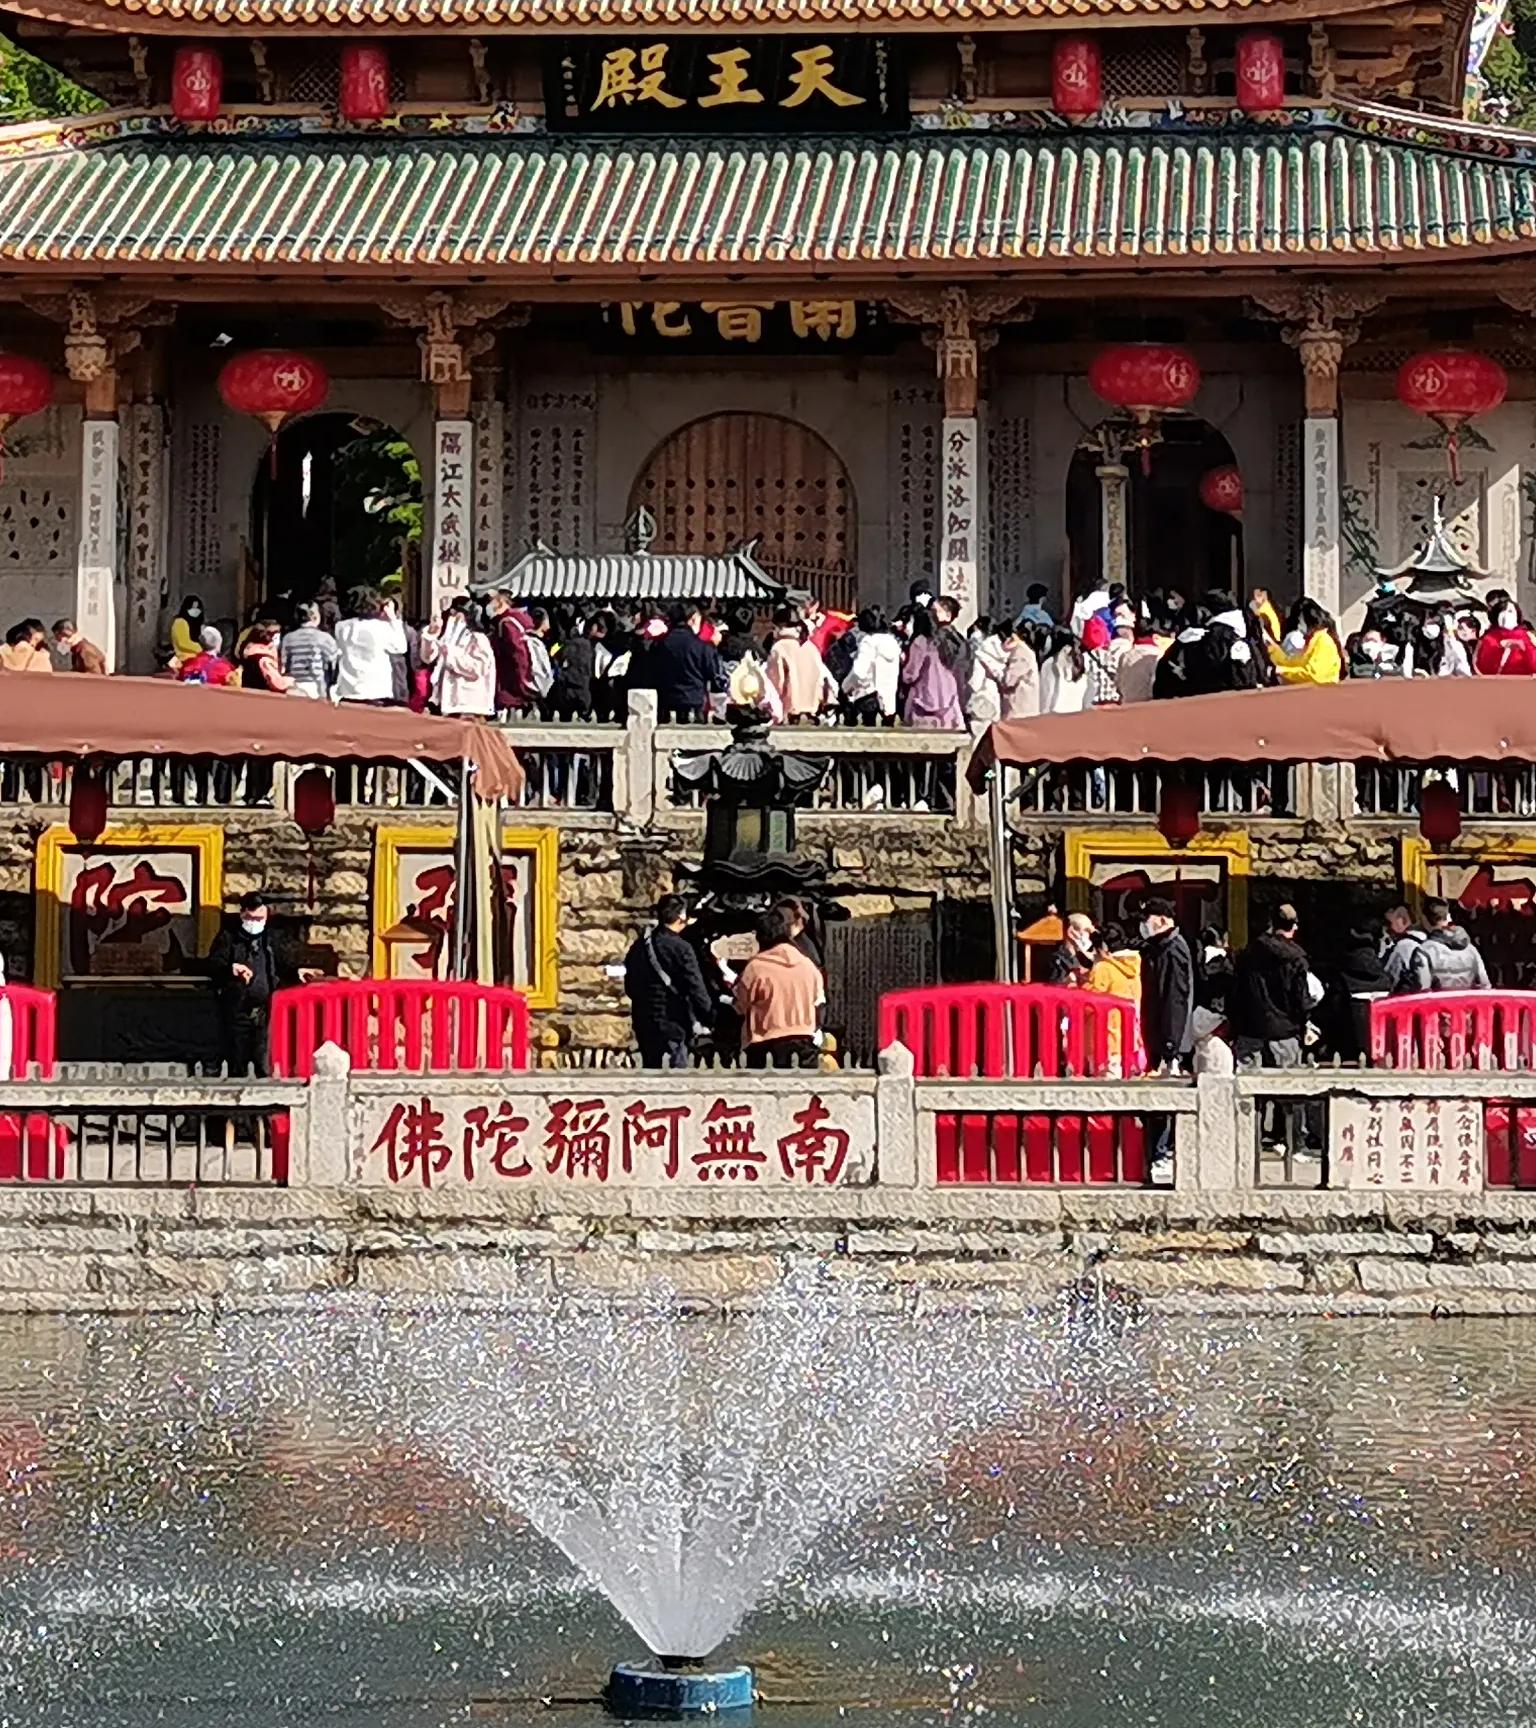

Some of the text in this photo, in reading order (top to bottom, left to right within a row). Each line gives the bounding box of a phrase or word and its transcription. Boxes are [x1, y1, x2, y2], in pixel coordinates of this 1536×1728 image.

[590, 43, 867, 111] 天王殿
[69, 860, 187, 975] 陀
[370, 1095, 851, 1188] 南無阿彌陀佛
